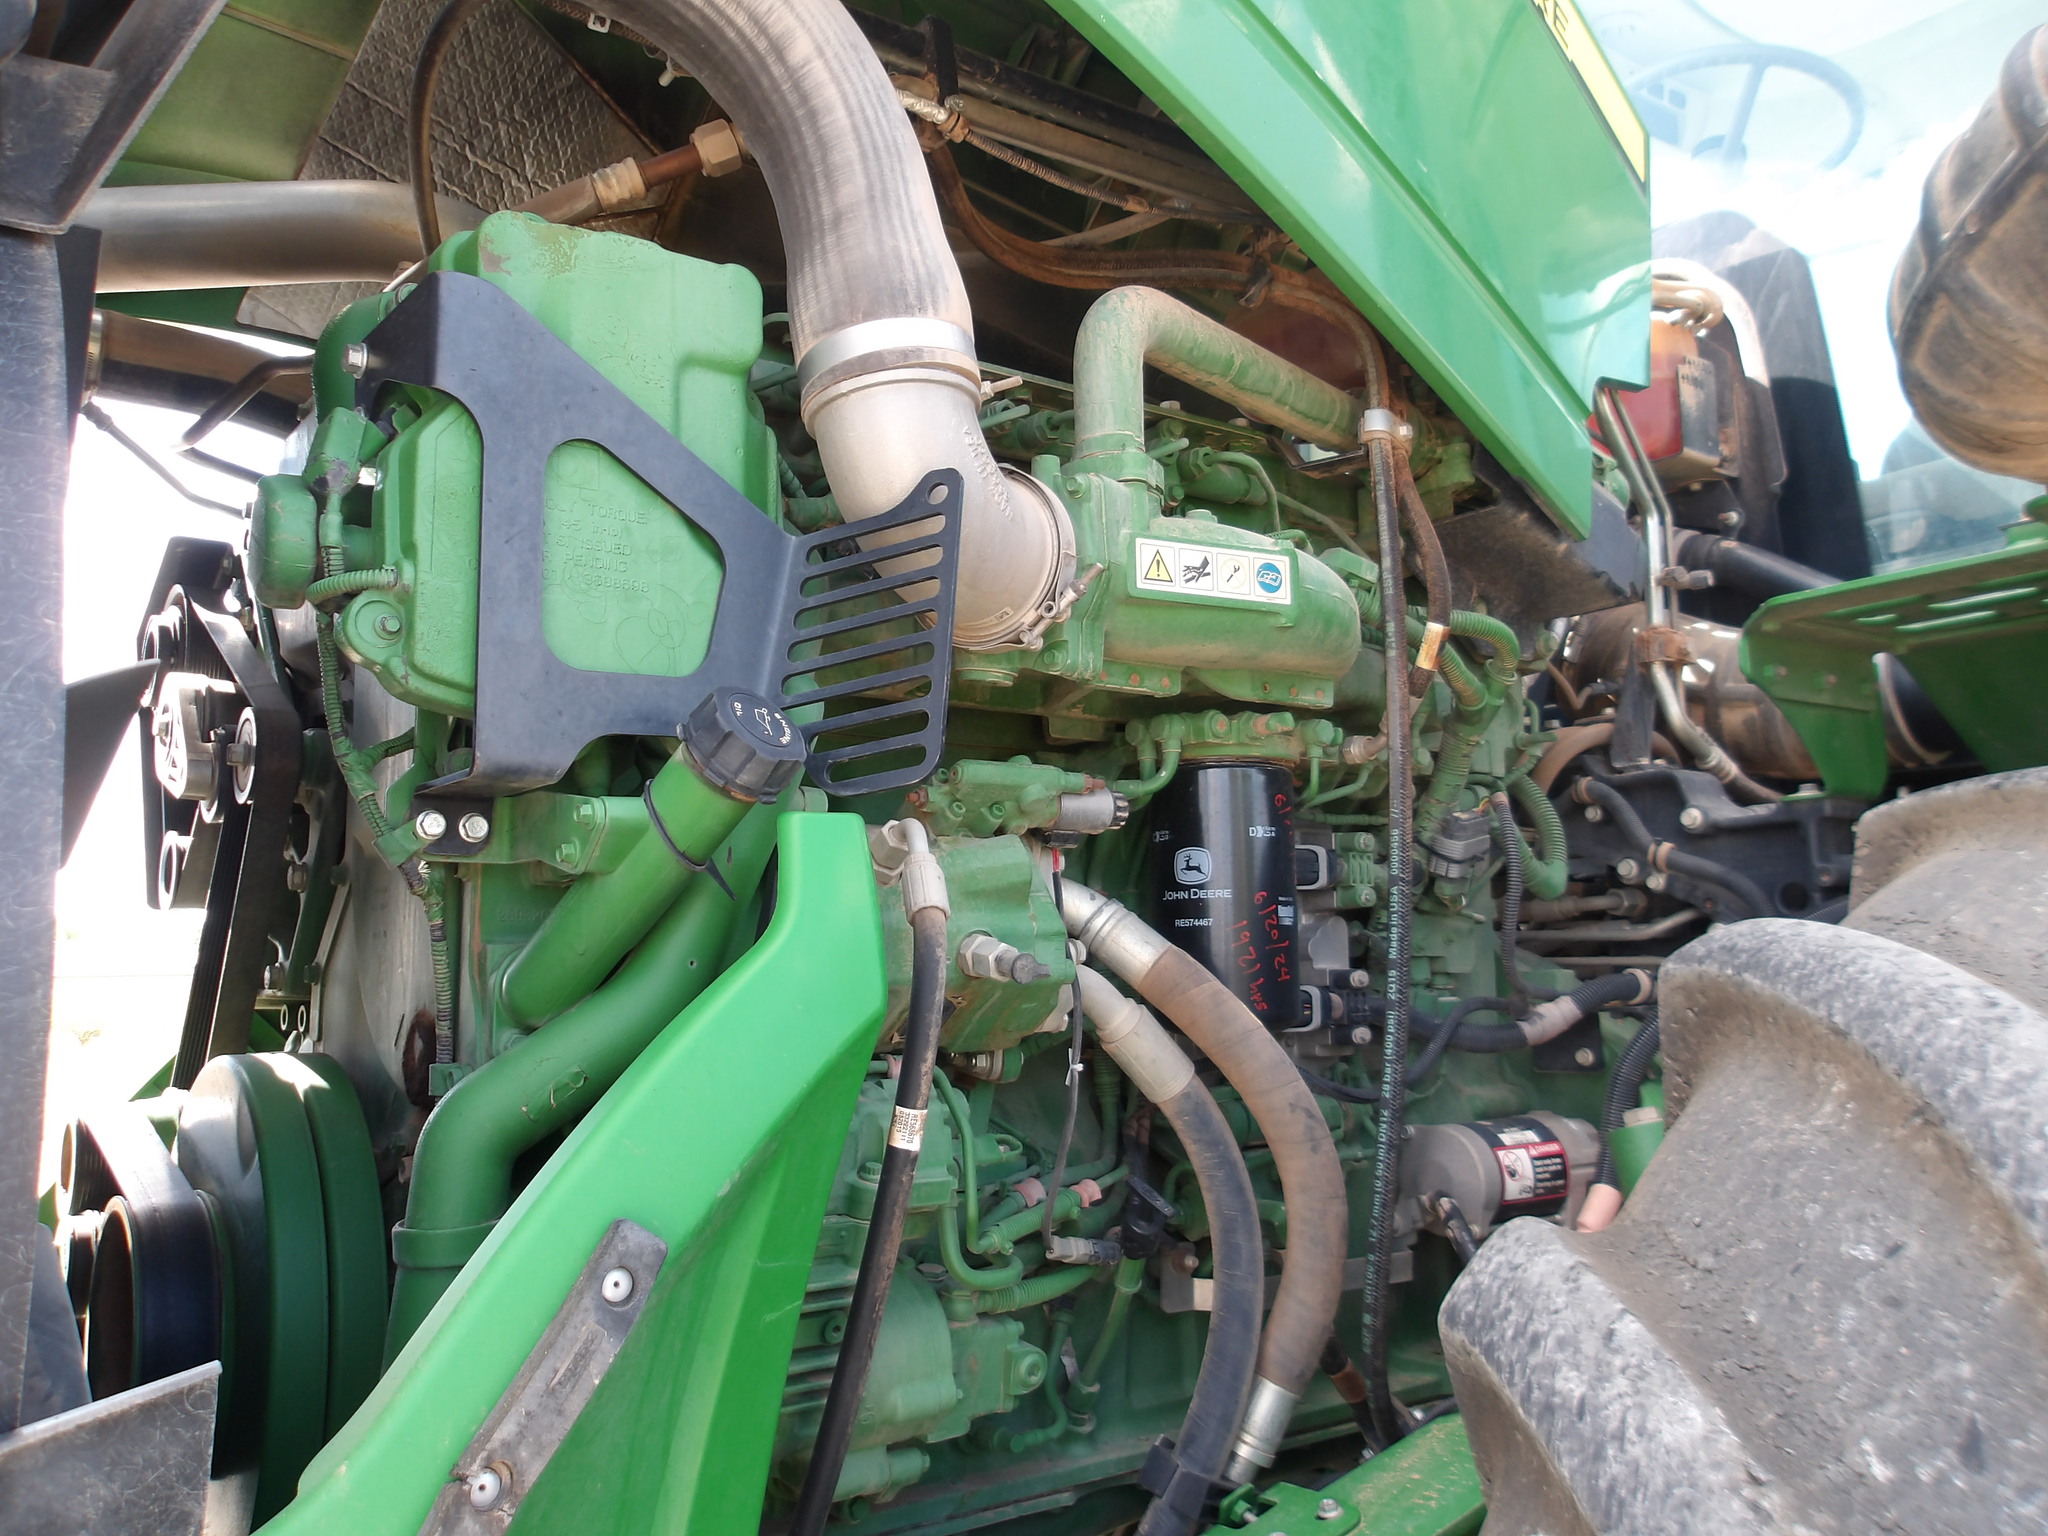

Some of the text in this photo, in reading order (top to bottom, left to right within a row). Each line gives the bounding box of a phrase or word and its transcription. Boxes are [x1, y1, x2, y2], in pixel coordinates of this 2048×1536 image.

[588, 503, 649, 525] TORQUE
[580, 538, 633, 556] ISSUED
[564, 553, 629, 573] PENDING
[734, 701, 743, 716] OIL
[1162, 888, 1232, 900] JOHN DEERE
[1390, 885, 1398, 911] USA
[1174, 918, 1213, 927] RE574467
[1389, 914, 1398, 924] in
[1388, 927, 1398, 959] Made
[1387, 969, 1396, 1000] 2Q15
[1386, 1011, 1396, 1033] psi)
[1384, 1034, 1394, 1060] (400
[1382, 1062, 1392, 1081] bar
[1381, 1084, 1390, 1098] 28
[1378, 1108, 1388, 1142] DN12
